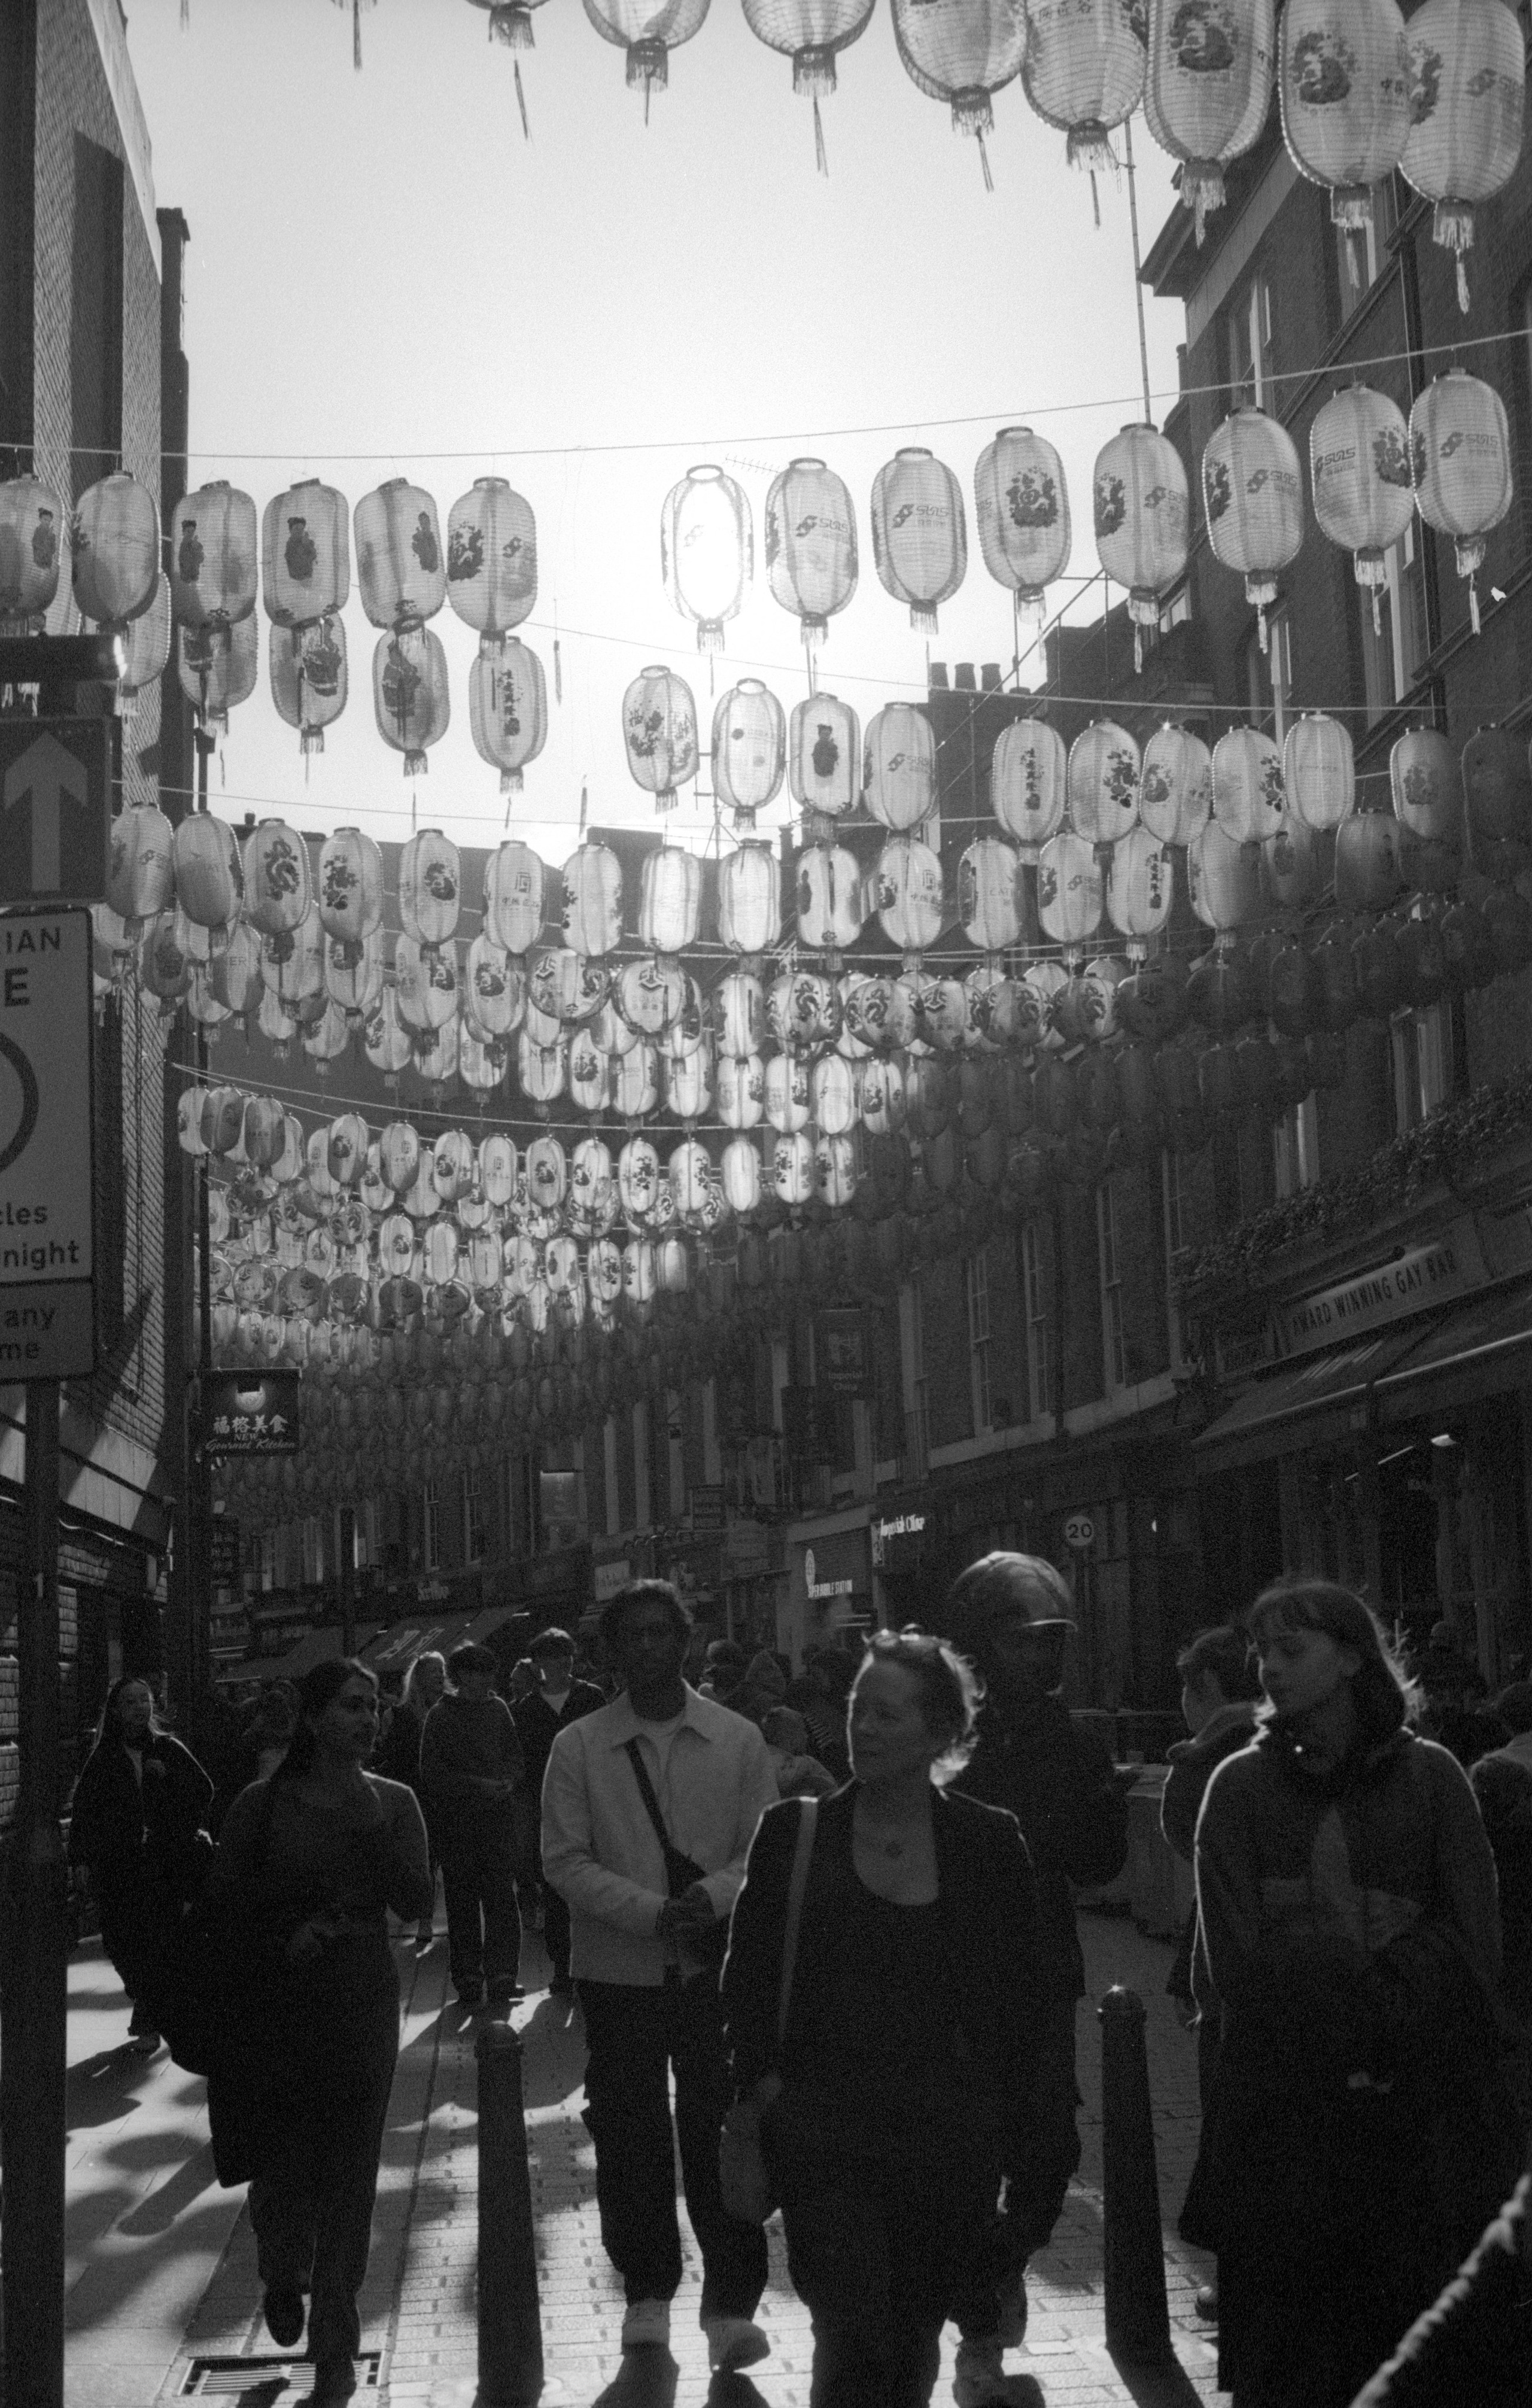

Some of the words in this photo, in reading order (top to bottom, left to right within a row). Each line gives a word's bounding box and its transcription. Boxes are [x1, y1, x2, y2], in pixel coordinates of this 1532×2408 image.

[1333, 1276, 1393, 1318] WINNING
[1395, 1262, 1424, 1294] GAY
[1425, 1248, 1458, 1281] BAR
[4, 1306, 56, 1331] any
[233, 1433, 259, 1442] NEW
[1068, 1522, 1093, 1539] 20
